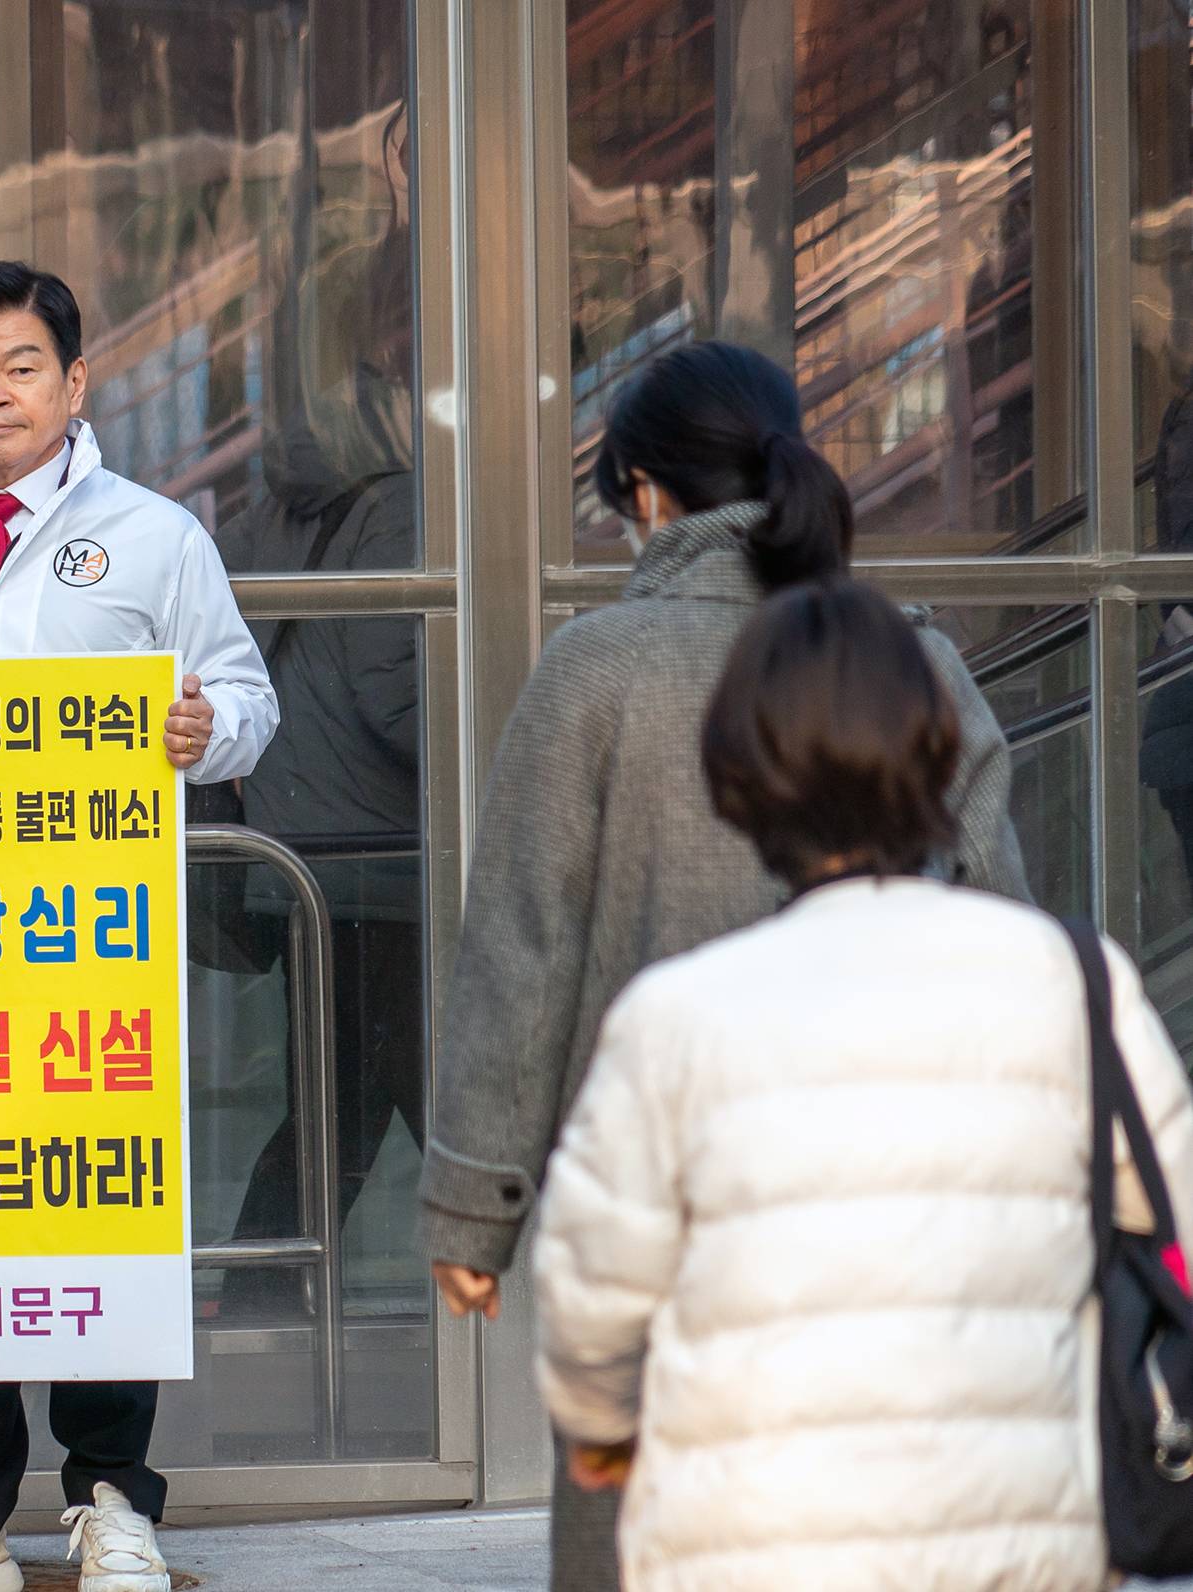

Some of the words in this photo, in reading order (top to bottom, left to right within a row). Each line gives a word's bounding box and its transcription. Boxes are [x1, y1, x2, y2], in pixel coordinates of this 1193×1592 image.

[58, 694, 148, 751] 약속!
[15, 790, 76, 843] 불편
[88, 789, 160, 841] 해소!
[39, 1008, 153, 1093] 신설
